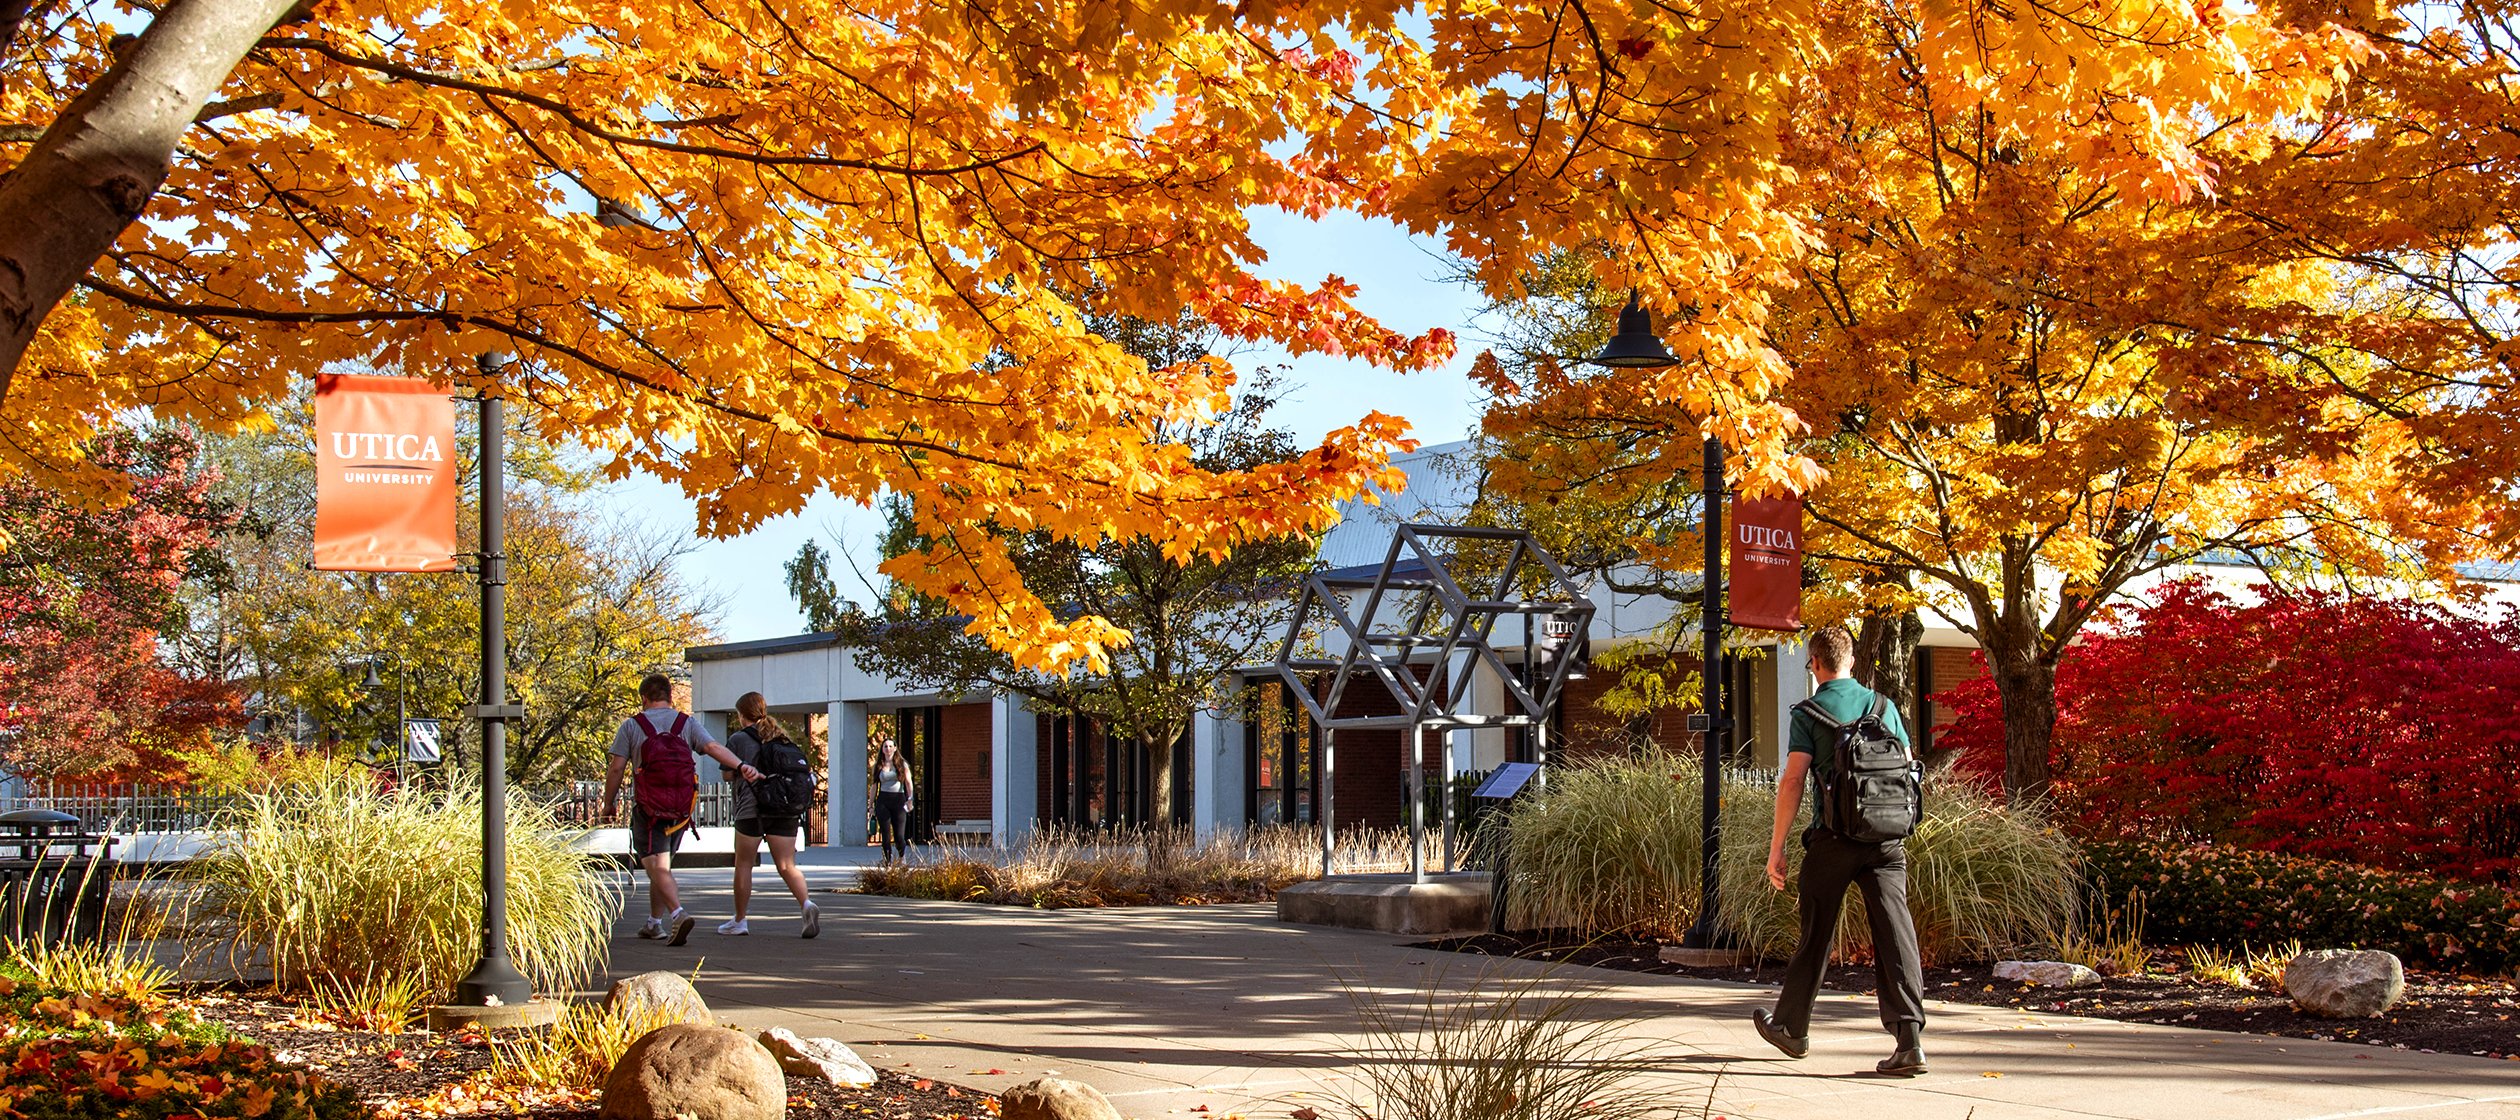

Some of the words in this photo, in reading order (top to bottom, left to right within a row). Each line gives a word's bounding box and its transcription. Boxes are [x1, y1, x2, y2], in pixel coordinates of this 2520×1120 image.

[332, 432, 443, 462] UTICA
[345, 472, 434, 485] UNIVERSITY
[1739, 524, 1796, 550] UTICA
[1744, 554, 1791, 567] UNIVERSITY
[1546, 621, 1577, 633] UTIC
